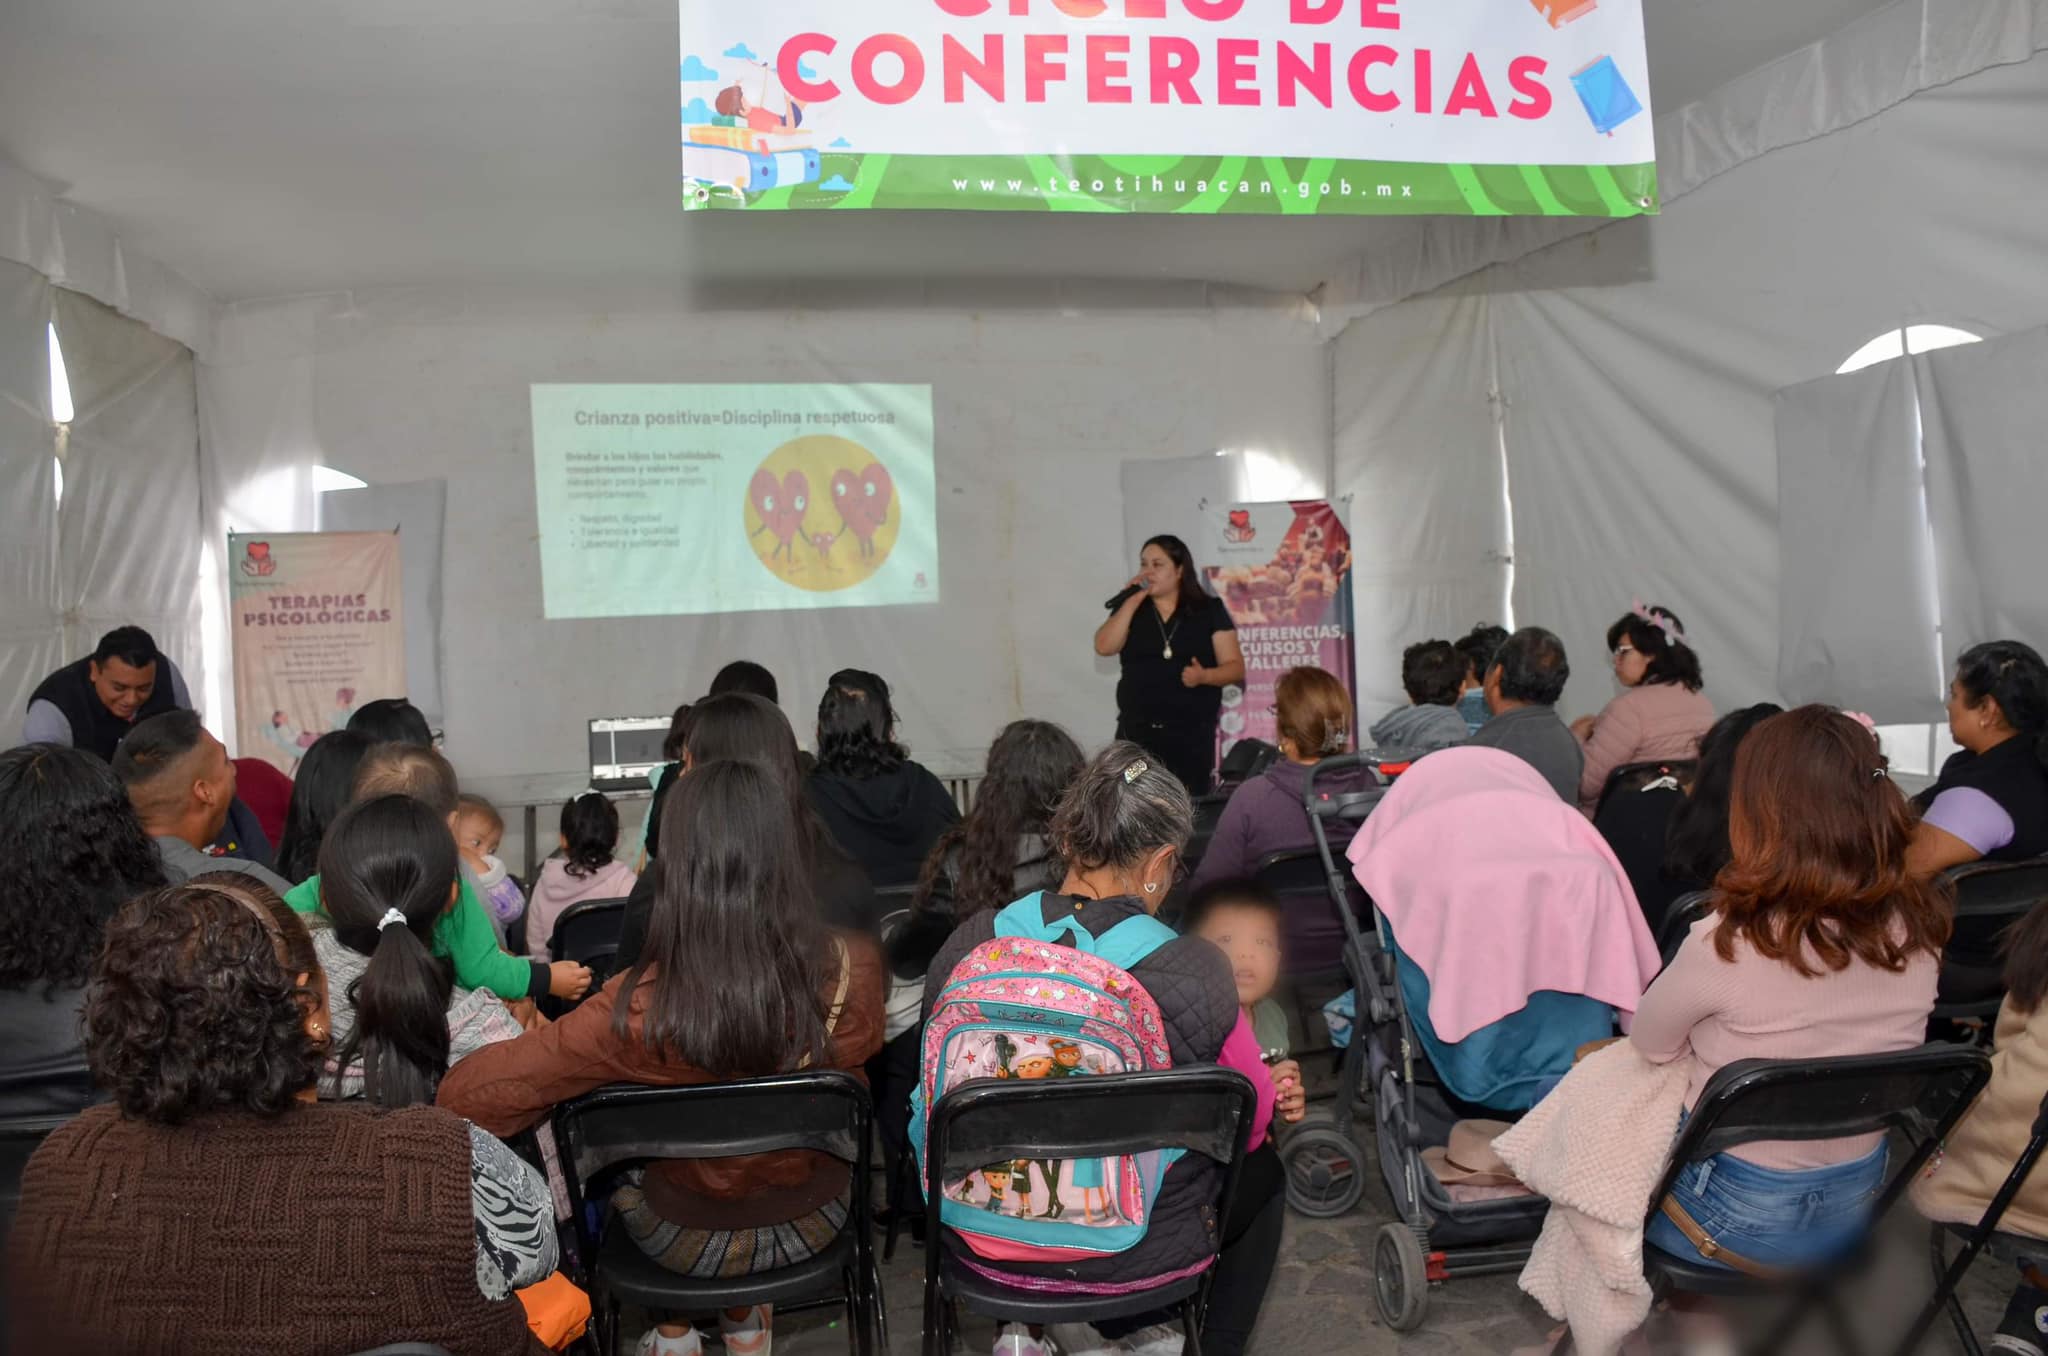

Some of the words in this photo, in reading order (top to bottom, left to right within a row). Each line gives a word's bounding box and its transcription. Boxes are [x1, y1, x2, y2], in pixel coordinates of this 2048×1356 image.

[777, 31, 1552, 120] CONFERENCIAS
[952, 175, 1413, 198] www.teotihuacan.gob.mx
[574, 410, 640, 426] Crianza
[806, 409, 896, 428] respetuosa
[268, 594, 367, 610] TERAPIAS
[1237, 624, 1346, 641] NFERENCIAS,
[1240, 641, 1306, 656] CURSOS
[1310, 640, 1321, 653] Y
